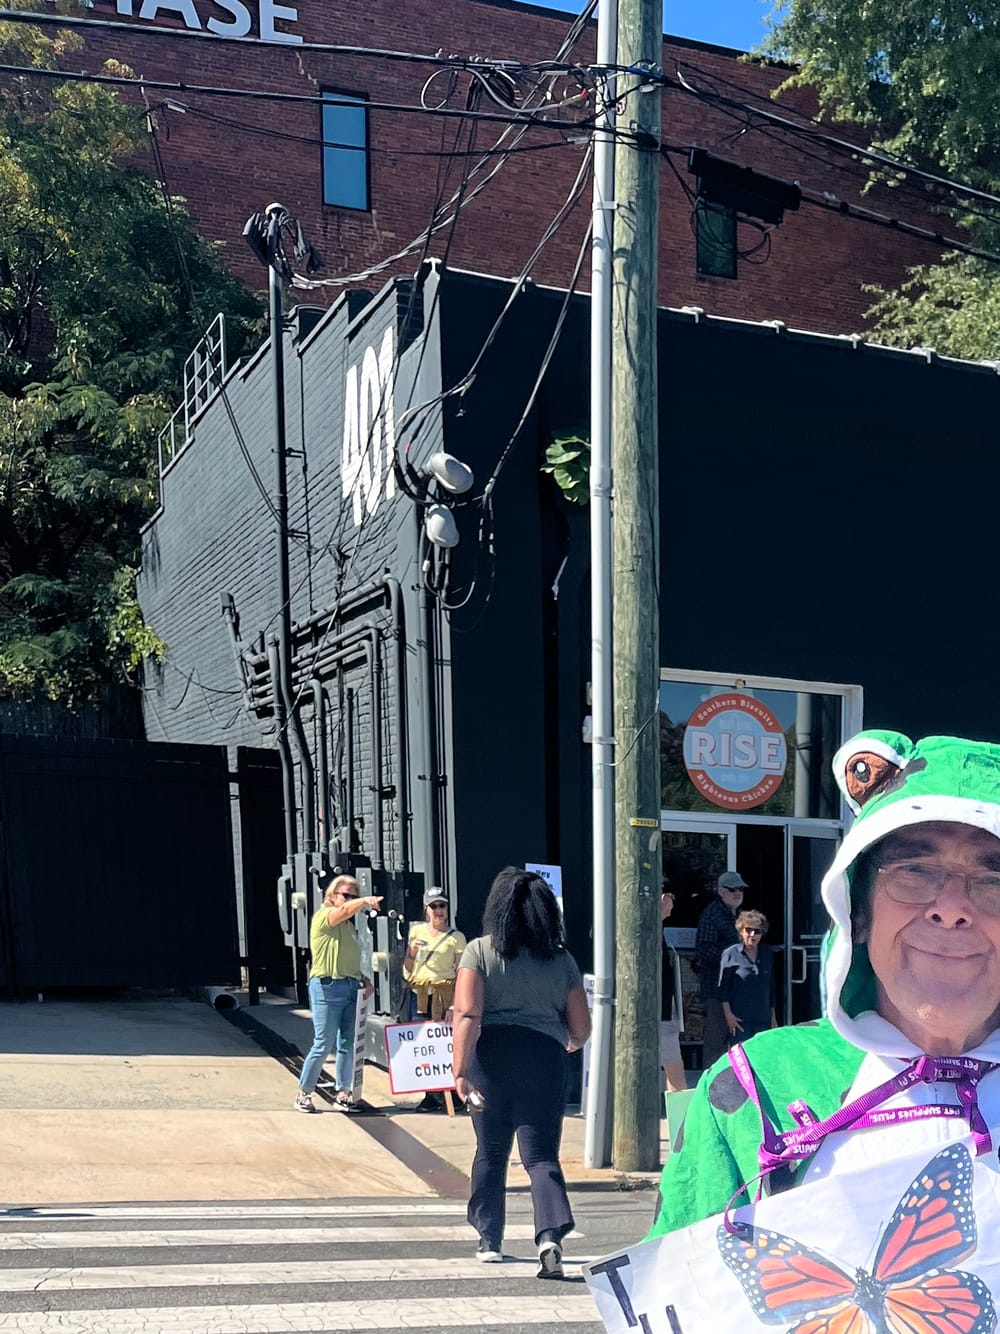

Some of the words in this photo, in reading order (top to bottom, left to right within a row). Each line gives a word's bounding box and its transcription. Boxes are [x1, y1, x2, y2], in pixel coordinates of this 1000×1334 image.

[697, 699, 737, 721] Southern
[740, 700, 774, 727] Biscuits
[690, 731, 782, 771] RISE
[696, 774, 739, 803] Righteous
[741, 780, 774, 802] Chicken
[398, 1030, 414, 1042] NO
[413, 1045, 436, 1057] FOR
[898, 1106, 942, 1119] SUPPLIES
